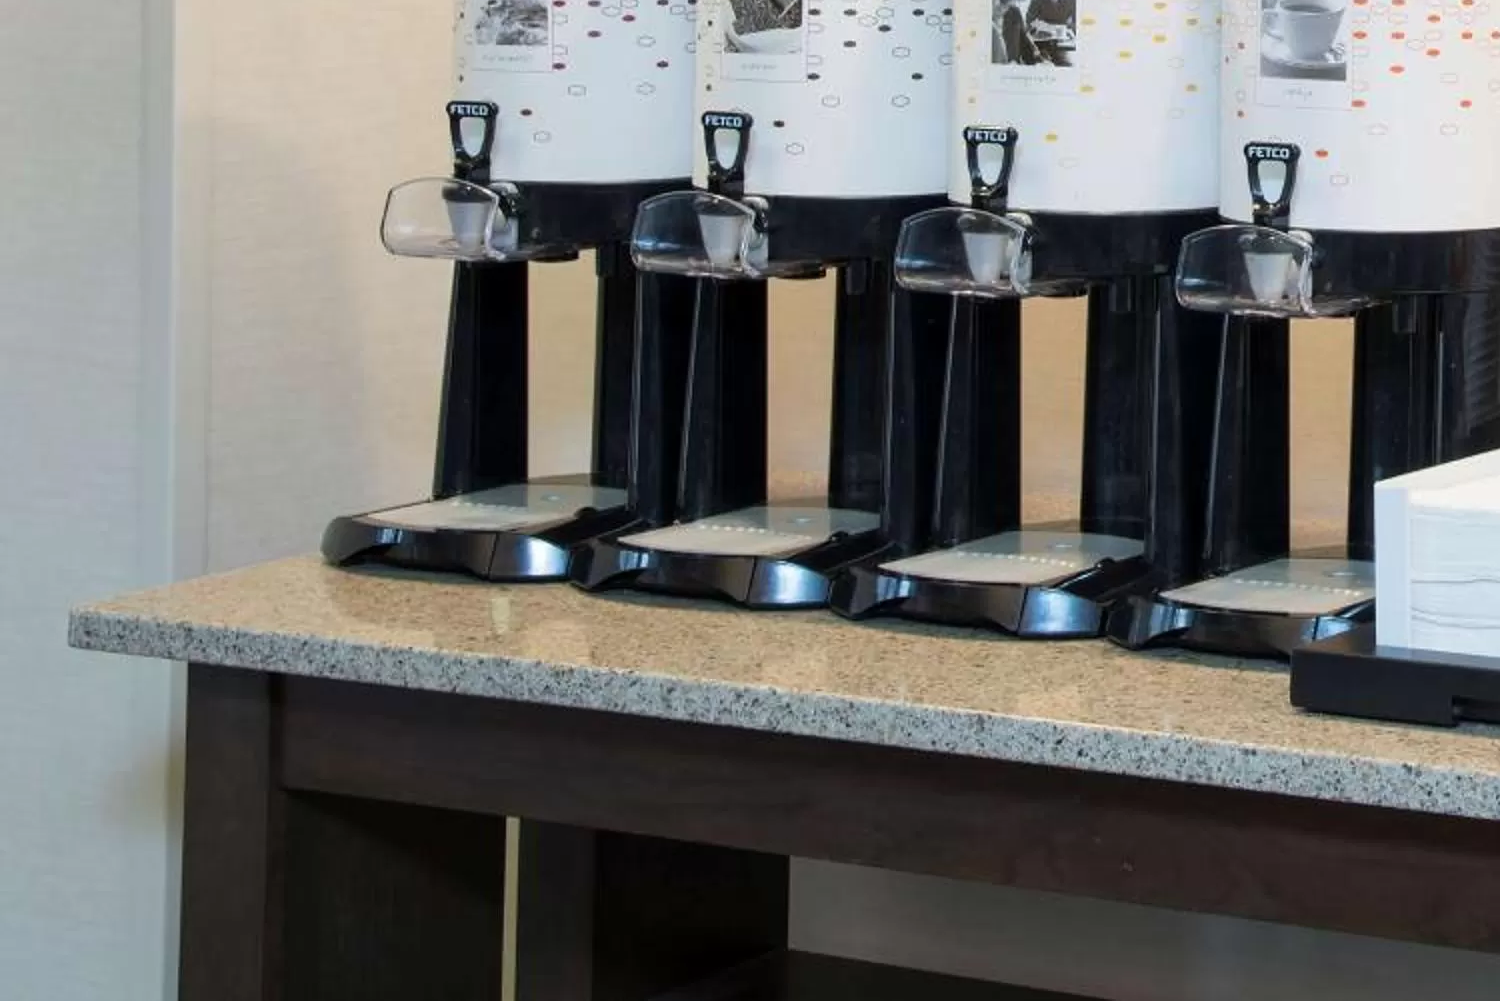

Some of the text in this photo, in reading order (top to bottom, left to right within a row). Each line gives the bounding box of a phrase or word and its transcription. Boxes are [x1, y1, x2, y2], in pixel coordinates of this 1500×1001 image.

[450, 104, 488, 116] FETCO
[705, 115, 742, 128] FETCO
[967, 130, 1007, 142] FETCO
[1249, 146, 1289, 159] FETCO
